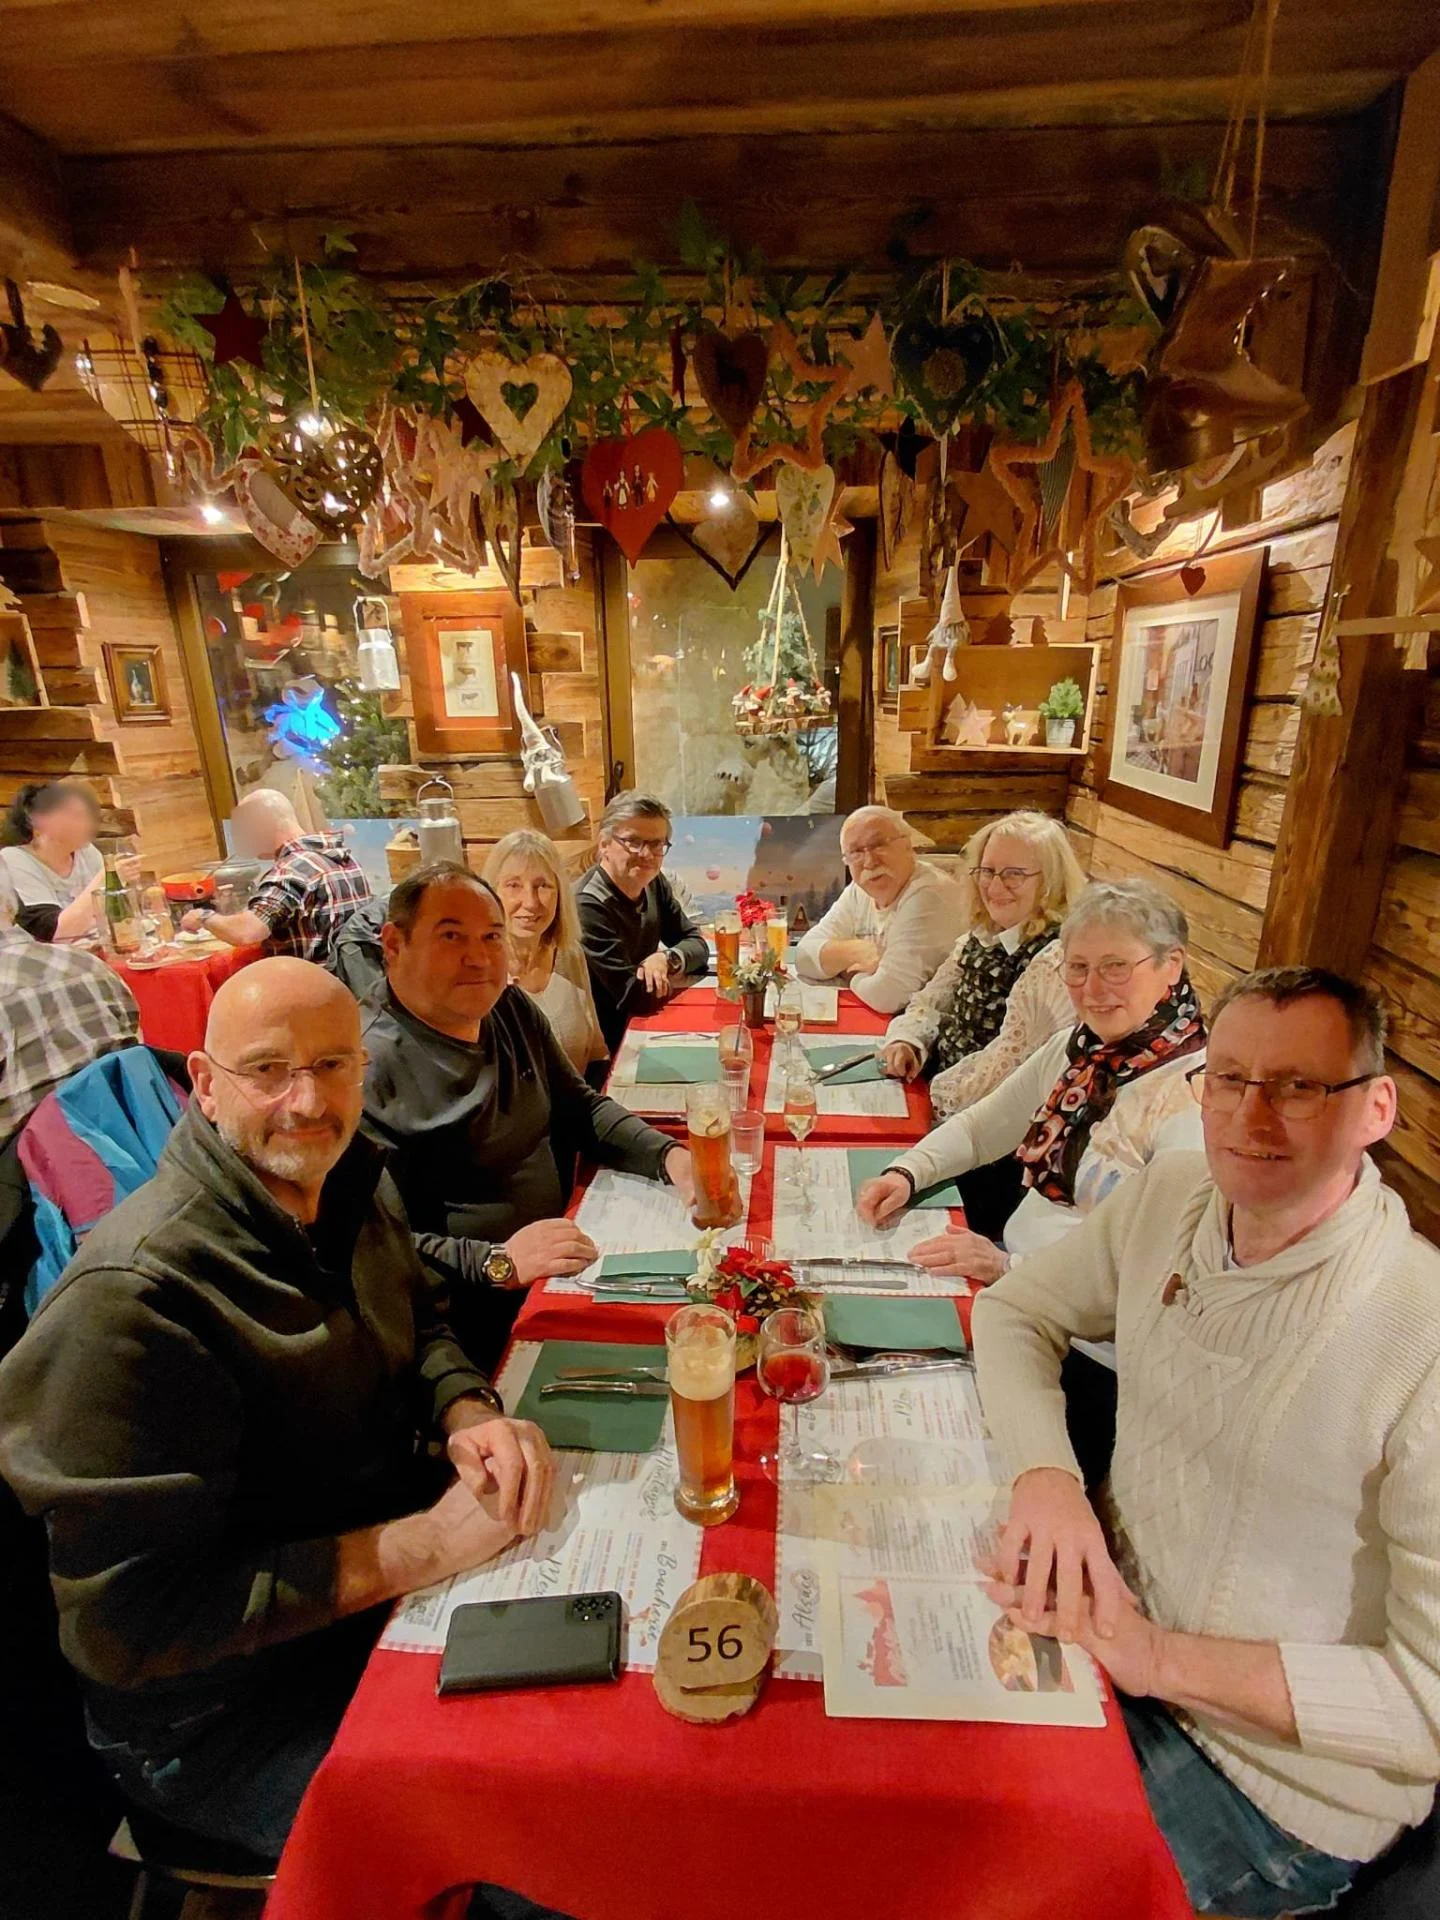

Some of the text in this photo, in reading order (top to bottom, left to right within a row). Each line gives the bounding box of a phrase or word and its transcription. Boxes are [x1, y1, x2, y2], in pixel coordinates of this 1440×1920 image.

[648, 1552, 678, 1642] Boucherie
[791, 1574, 815, 1632] Alsace
[686, 1625, 743, 1663] 56
